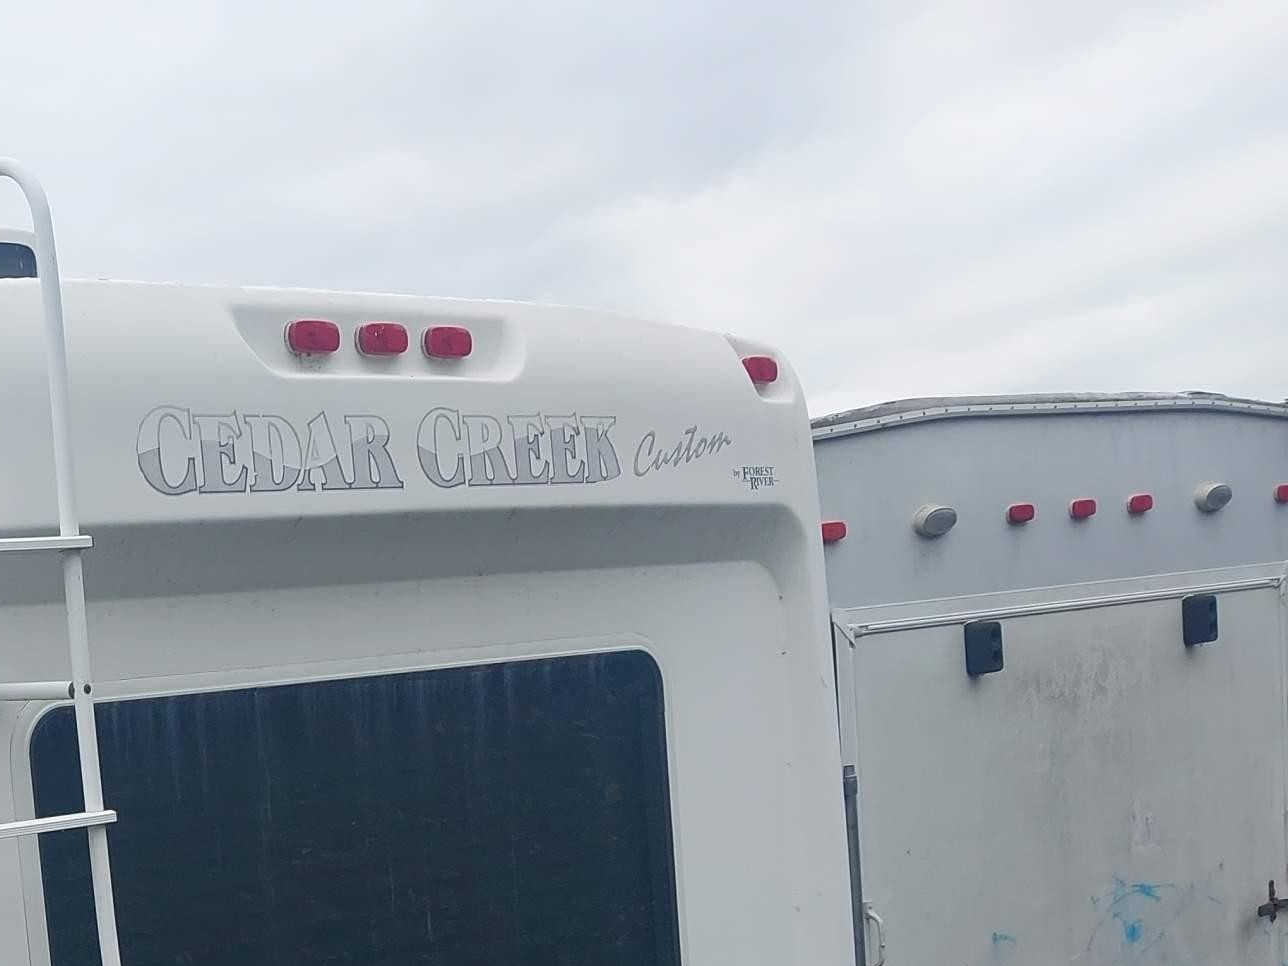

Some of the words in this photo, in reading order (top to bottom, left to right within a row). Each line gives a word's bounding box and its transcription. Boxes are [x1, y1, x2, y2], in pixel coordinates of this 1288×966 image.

[136, 405, 404, 496] CEDAR
[416, 407, 621, 488] CREEK
[633, 425, 732, 477] Custom
[742, 466, 775, 480] FOREST
[749, 476, 775, 490] RIVER
